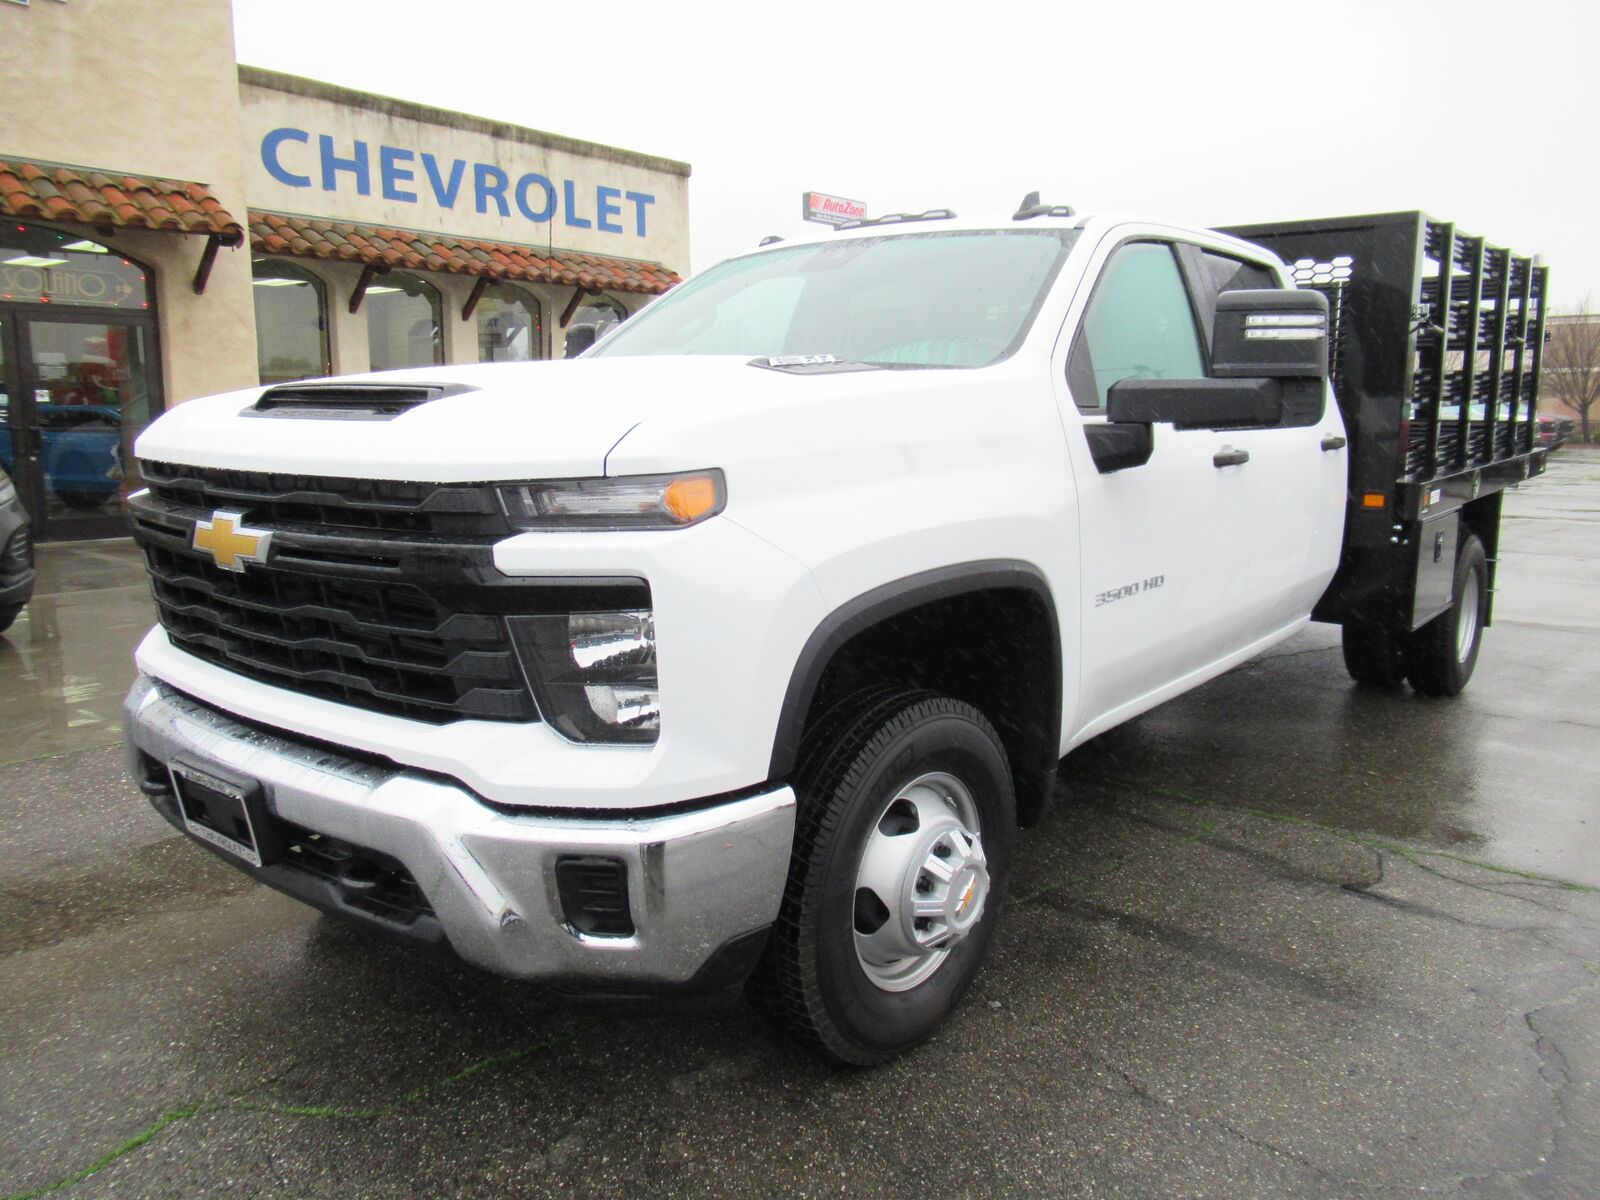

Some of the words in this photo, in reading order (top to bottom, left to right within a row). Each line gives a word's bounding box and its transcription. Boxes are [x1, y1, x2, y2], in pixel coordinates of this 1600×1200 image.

[261, 127, 655, 237] CHEVROLET
[823, 198, 865, 217] AutoZone
[1, 267, 106, 298] SOLANO
[1095, 582, 1140, 608] 3500
[1143, 574, 1165, 592] HD
